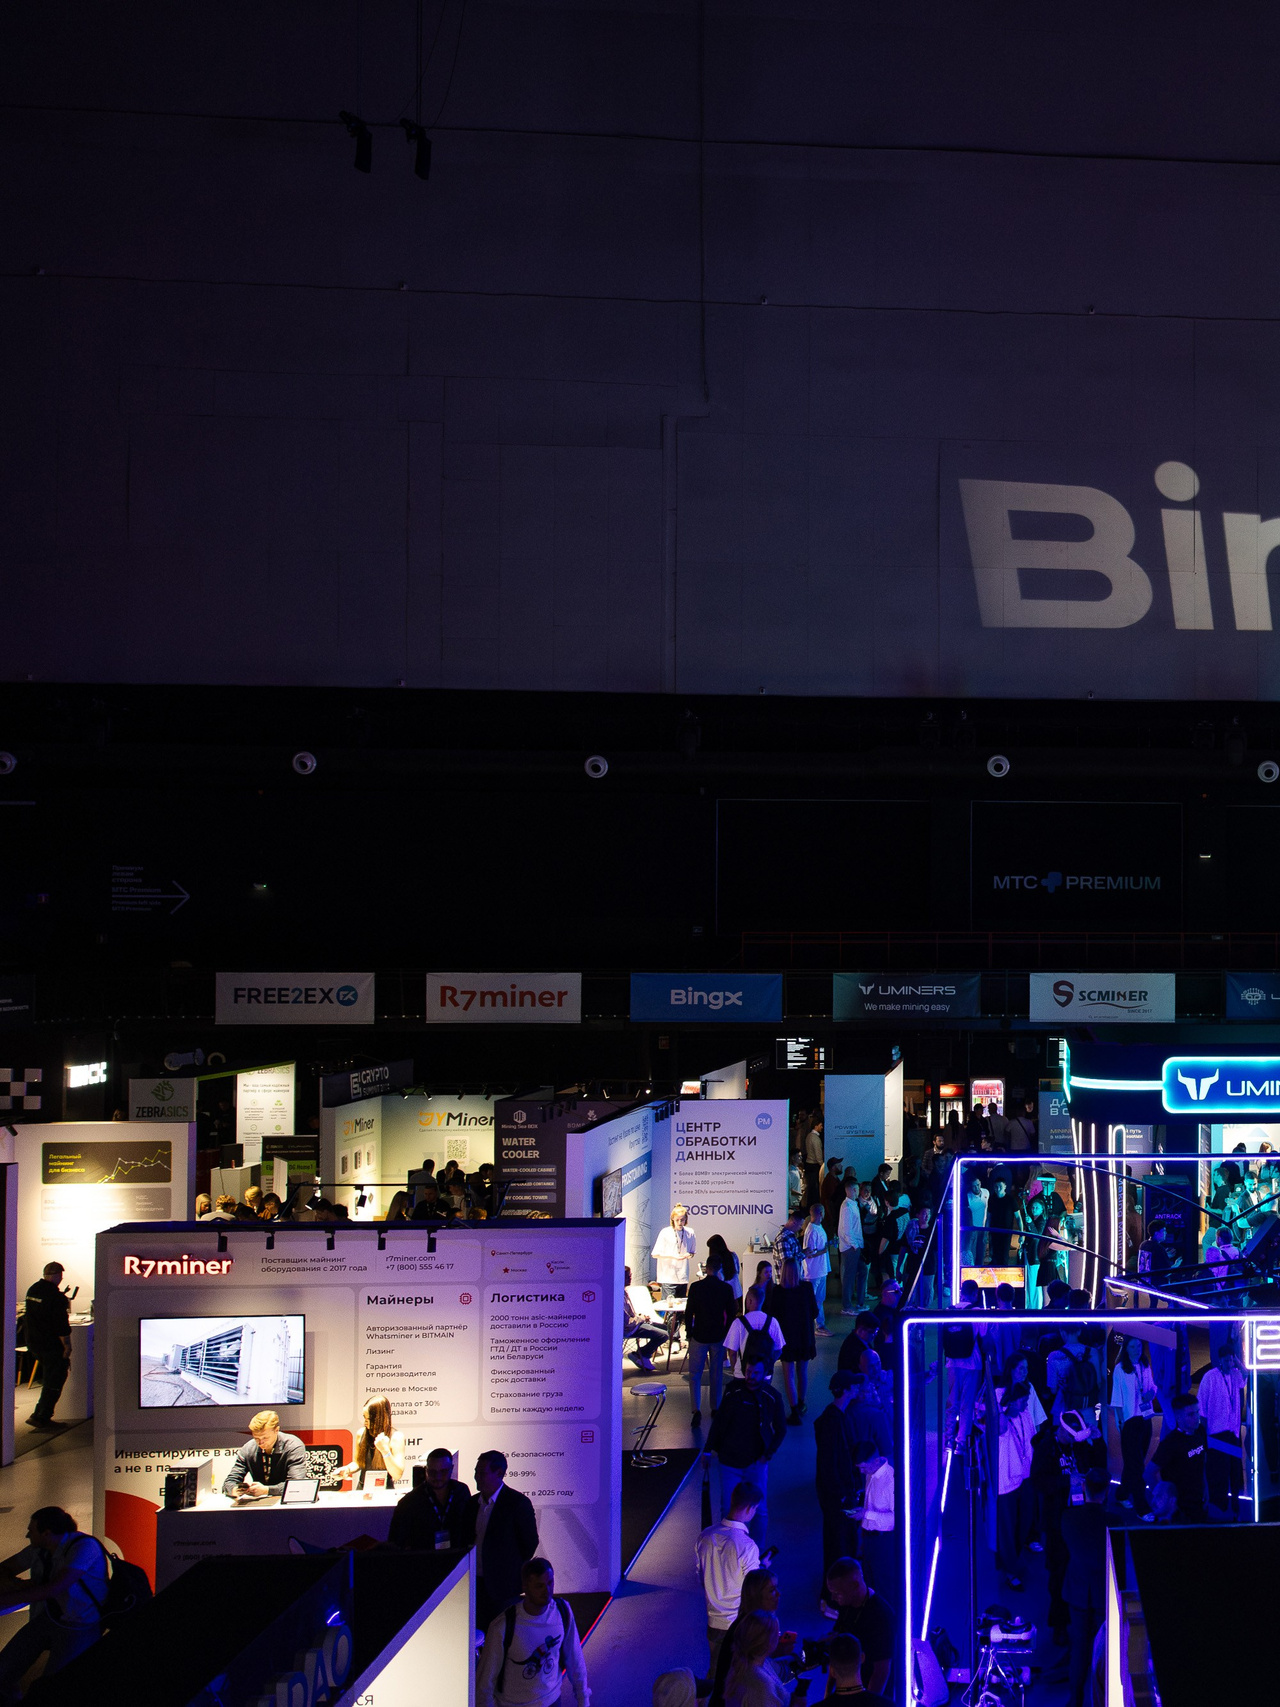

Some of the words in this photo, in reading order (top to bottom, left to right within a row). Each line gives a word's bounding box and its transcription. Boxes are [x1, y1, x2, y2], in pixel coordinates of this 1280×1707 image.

[1066, 875, 1161, 890] PREMIUM
[233, 987, 334, 1004] FREE2EX
[878, 986, 956, 996] UMINERS
[1079, 989, 1149, 1002] SCMINER
[440, 984, 568, 1011] R7miner
[670, 988, 743, 1010] Bingx
[864, 1003, 880, 1012] We
[881, 1003, 901, 1012] make
[902, 1003, 927, 1014] mining
[928, 1004, 951, 1014] easy
[361, 1066, 389, 1084] CRYPTO
[136, 1106, 189, 1119] ZEBRASICS
[676, 1122, 721, 1134] ЦЕНТР
[502, 1138, 536, 1146] WATER
[675, 1136, 757, 1147] ОБРАБОТКИ
[502, 1151, 540, 1159] COOLER
[675, 1151, 736, 1162] ДАННЫХ
[261, 1257, 308, 1265] Поставщик
[309, 1256, 346, 1264] майнинг
[123, 1254, 232, 1278] R7miner
[261, 1266, 321, 1274] оборудования
[397, 1263, 417, 1271] (800)
[366, 1294, 434, 1306] Майнеры
[490, 1292, 565, 1303] Логистика
[531, 1313, 586, 1321] asic-майнеров
[366, 1324, 434, 1332] Авторизованный
[435, 1323, 468, 1332] партнёр
[543, 1336, 590, 1345] оформление
[507, 1352, 544, 1361] Беларуси
[375, 1371, 437, 1379] производителя
[490, 1367, 556, 1376] Фиксированный
[490, 1391, 540, 1399] Страхование
[541, 1391, 564, 1399] груза
[522, 1406, 553, 1414] каждую
[114, 1448, 210, 1460] Инвестируйте
[125, 1465, 141, 1473] не
[557, 1490, 574, 1498] году
